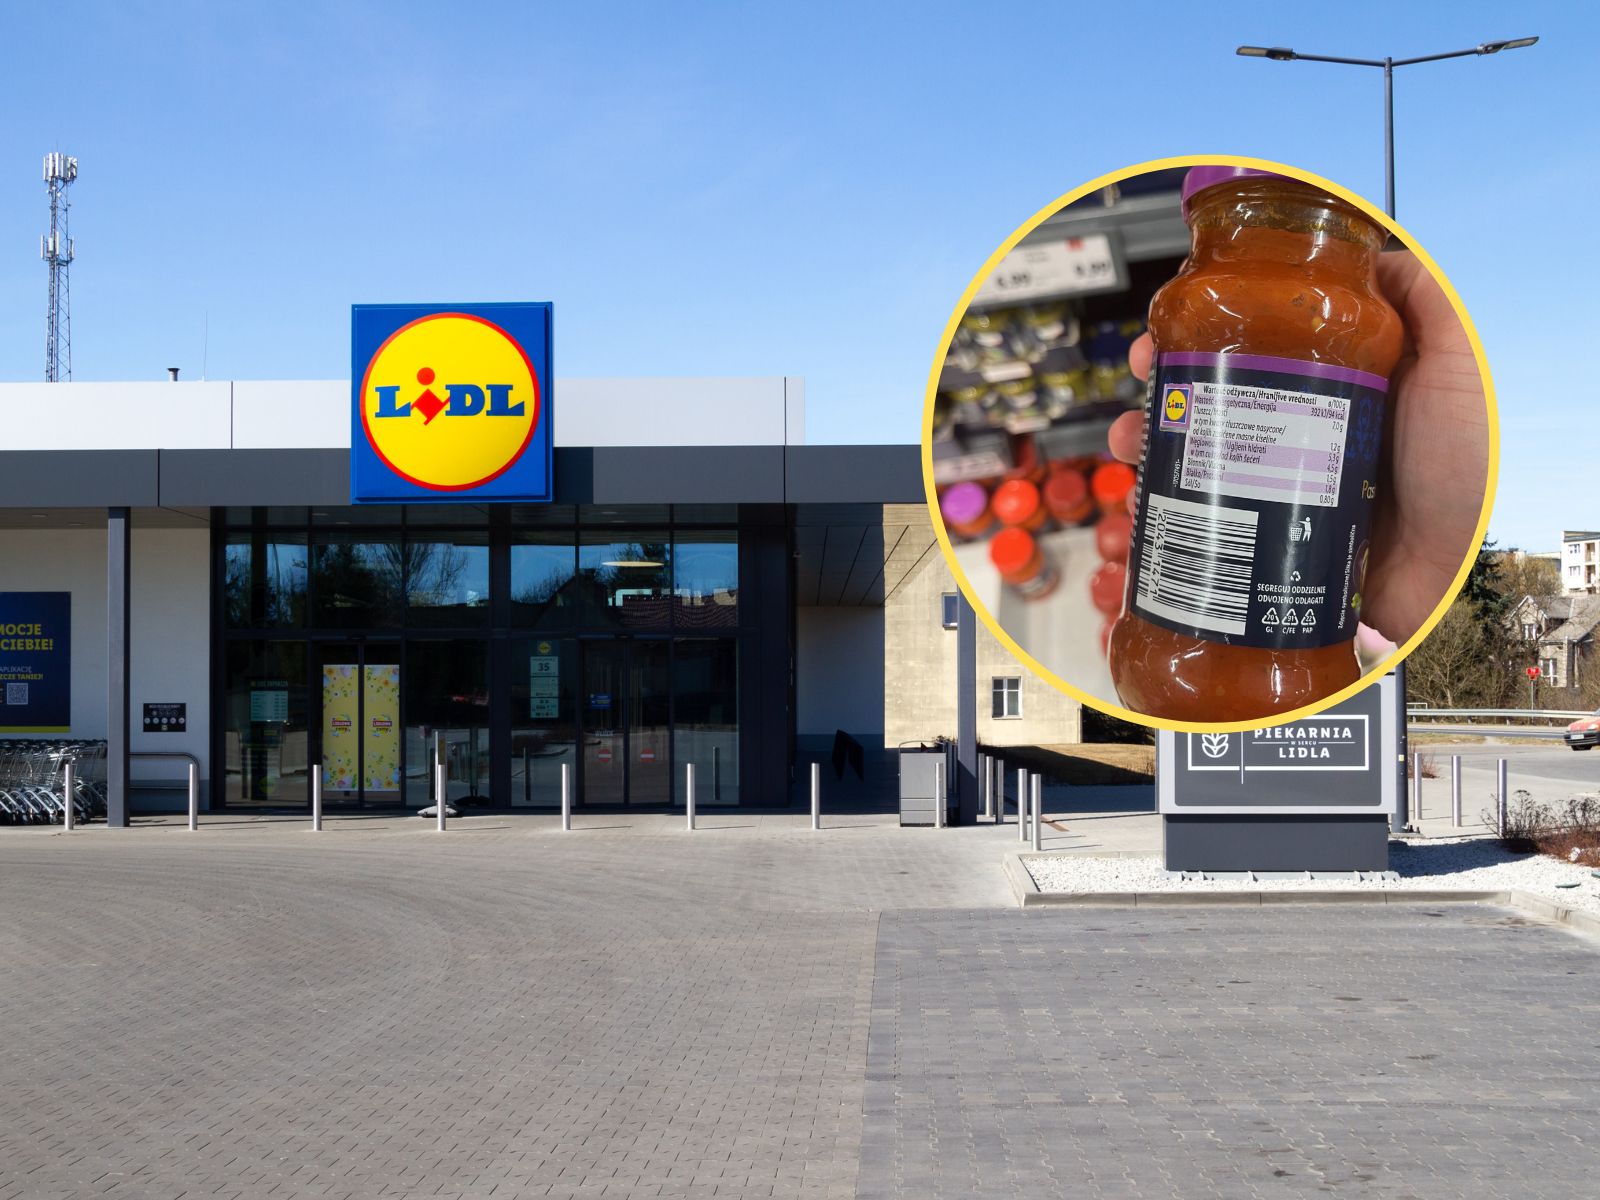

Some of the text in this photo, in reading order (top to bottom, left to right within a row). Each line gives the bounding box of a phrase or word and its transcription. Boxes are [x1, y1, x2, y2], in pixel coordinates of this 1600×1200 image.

[1288, 395, 1318, 406] vrednosti
[1257, 583, 1326, 594] SEGREGUJ ODDZIELNIE
[1257, 594, 1324, 605] ODVOJENO ODLAGATI
[1, 638, 54, 651] CIEBIE!
[537, 662, 550, 672] 35
[1254, 727, 1352, 739] PIEKARNIA
[1279, 747, 1330, 758] LIDLA
